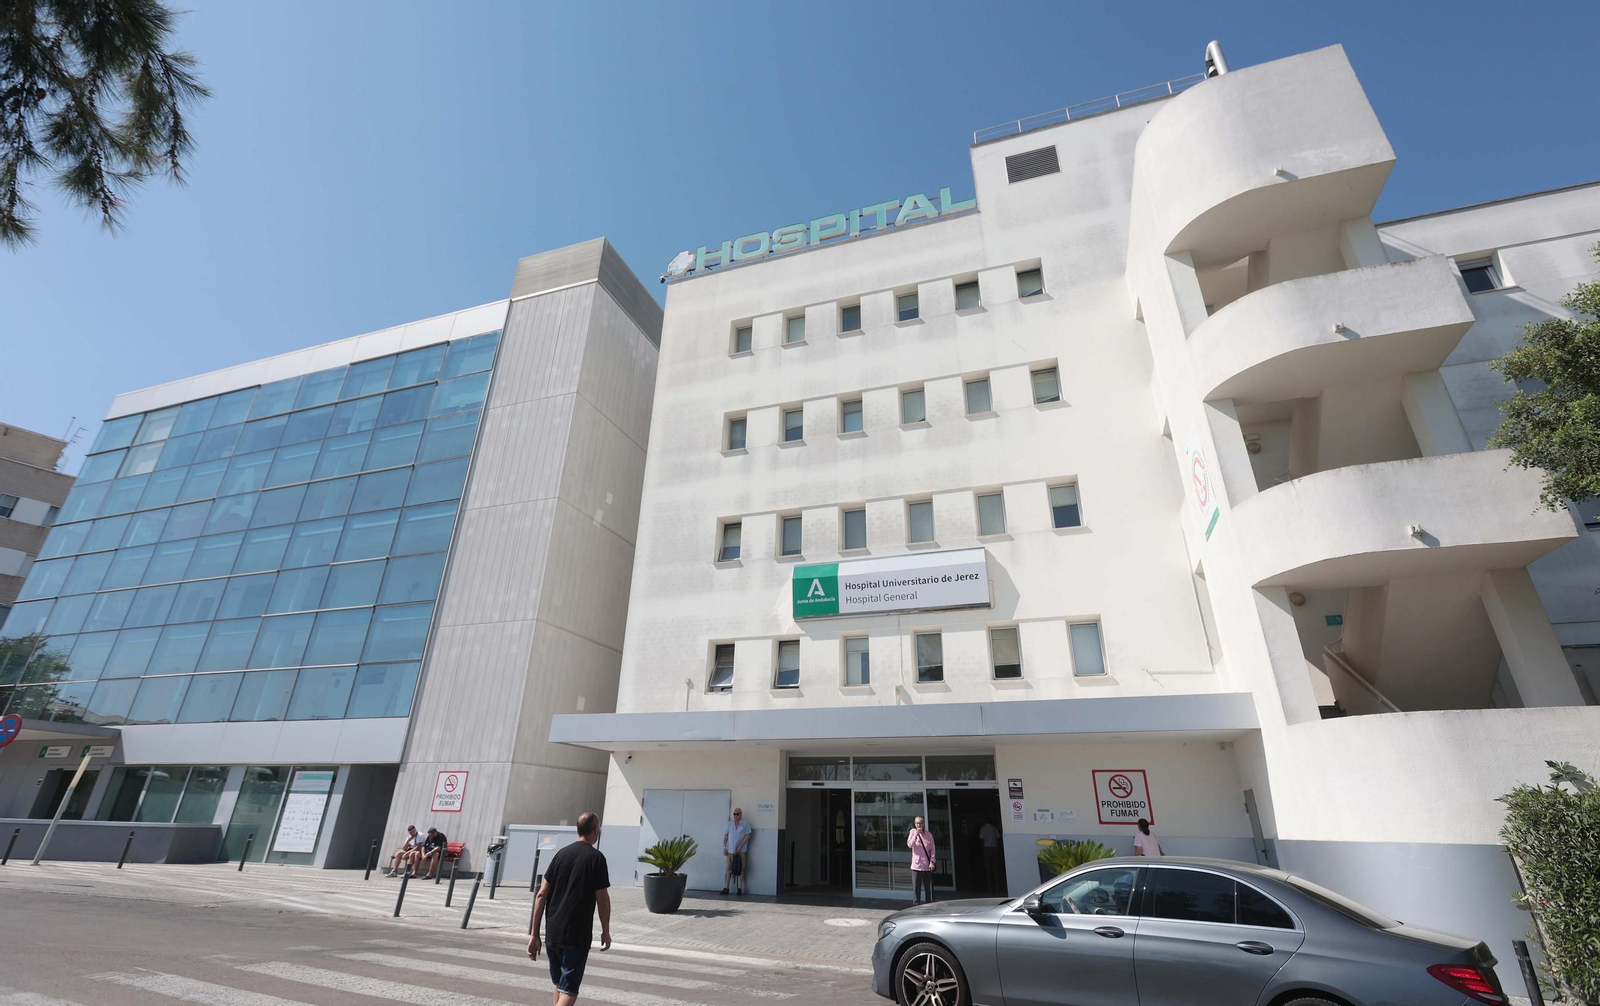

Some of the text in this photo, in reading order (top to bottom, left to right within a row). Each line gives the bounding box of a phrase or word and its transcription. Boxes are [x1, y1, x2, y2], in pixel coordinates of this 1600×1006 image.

[695, 187, 976, 272] HOSPITAL
[845, 572, 980, 592] Hospital Universitario de Jerez
[845, 591, 918, 605] Hospital General
[1101, 800, 1146, 809] PROHIBIDO
[1110, 809, 1139, 817] FUMAR
